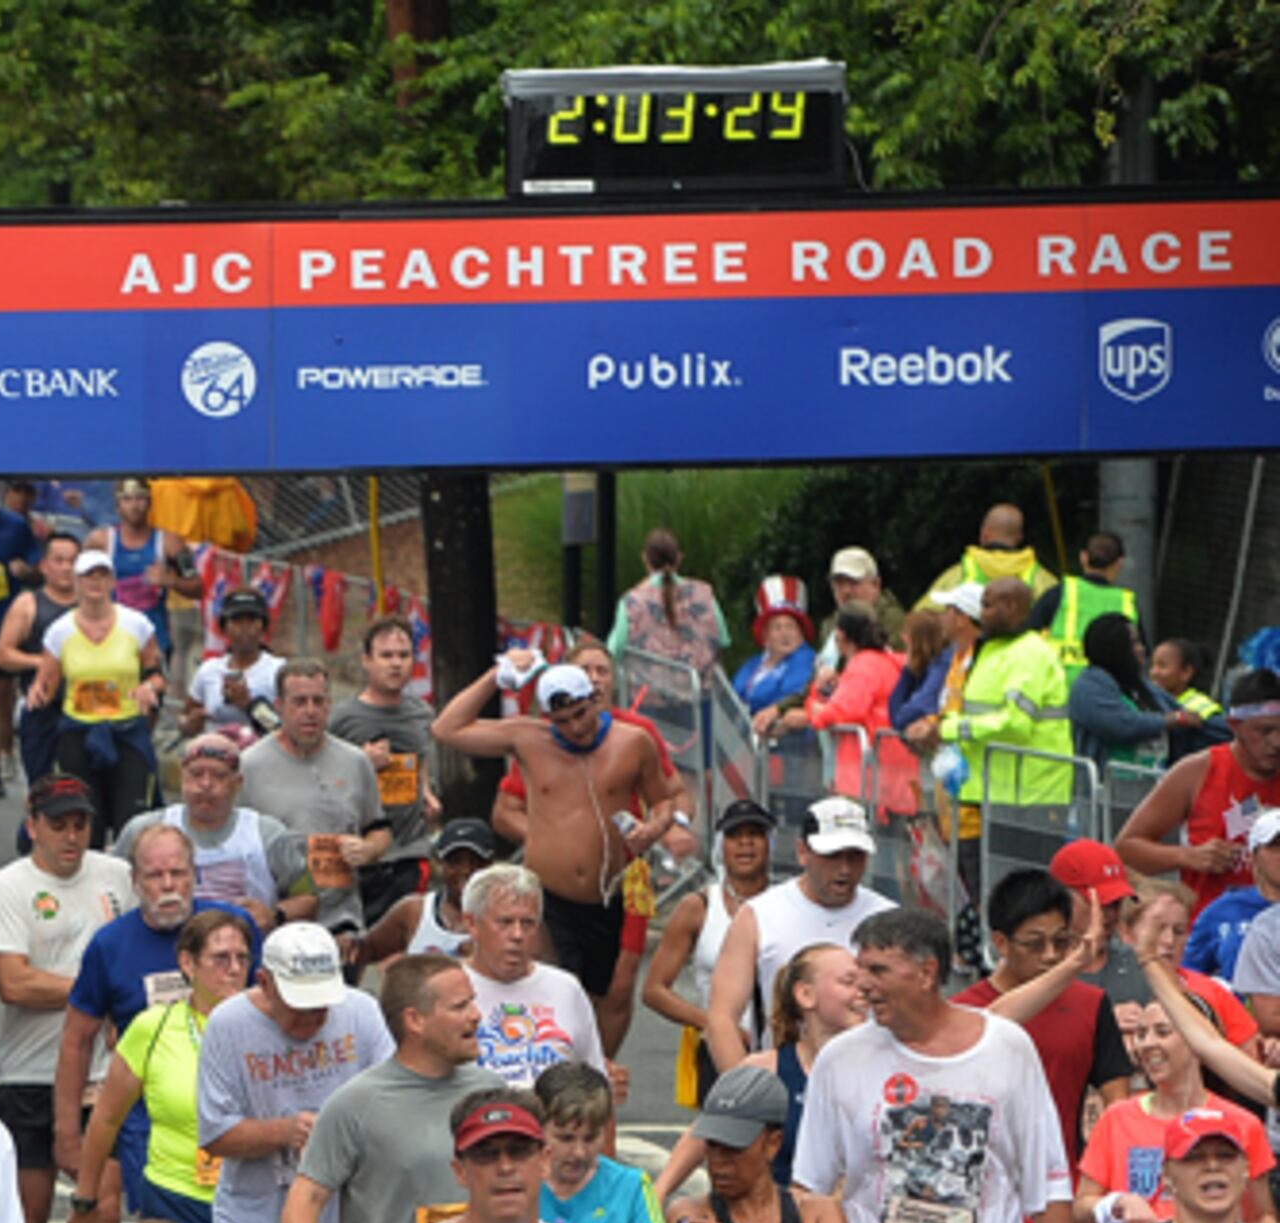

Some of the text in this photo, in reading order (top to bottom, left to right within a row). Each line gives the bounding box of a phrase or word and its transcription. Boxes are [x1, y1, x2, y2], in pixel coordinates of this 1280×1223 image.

[121, 230, 1232, 294] AJC PEACHTREE ROAD RACE
[25, 367, 120, 398] BANK
[298, 364, 488, 390] POWERADE
[841, 345, 1012, 386] Reebok
[1106, 344, 1165, 389] ups
